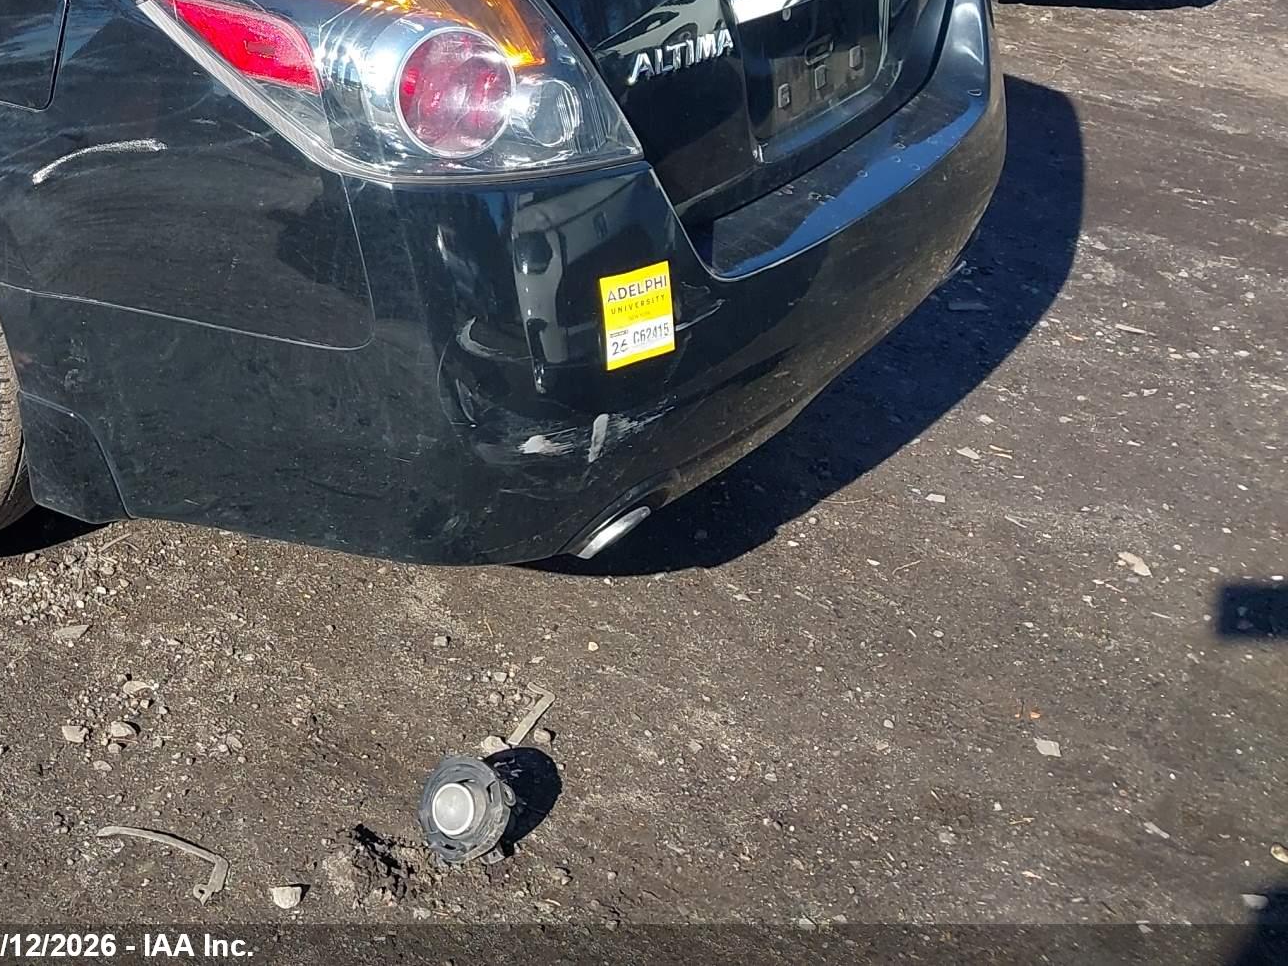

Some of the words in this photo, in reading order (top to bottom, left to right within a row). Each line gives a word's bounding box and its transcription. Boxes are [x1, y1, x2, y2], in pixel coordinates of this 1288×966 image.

[627, 28, 734, 84] ALTIMA
[607, 275, 668, 302] ADELPHI
[610, 294, 665, 315] UNIVERSITY
